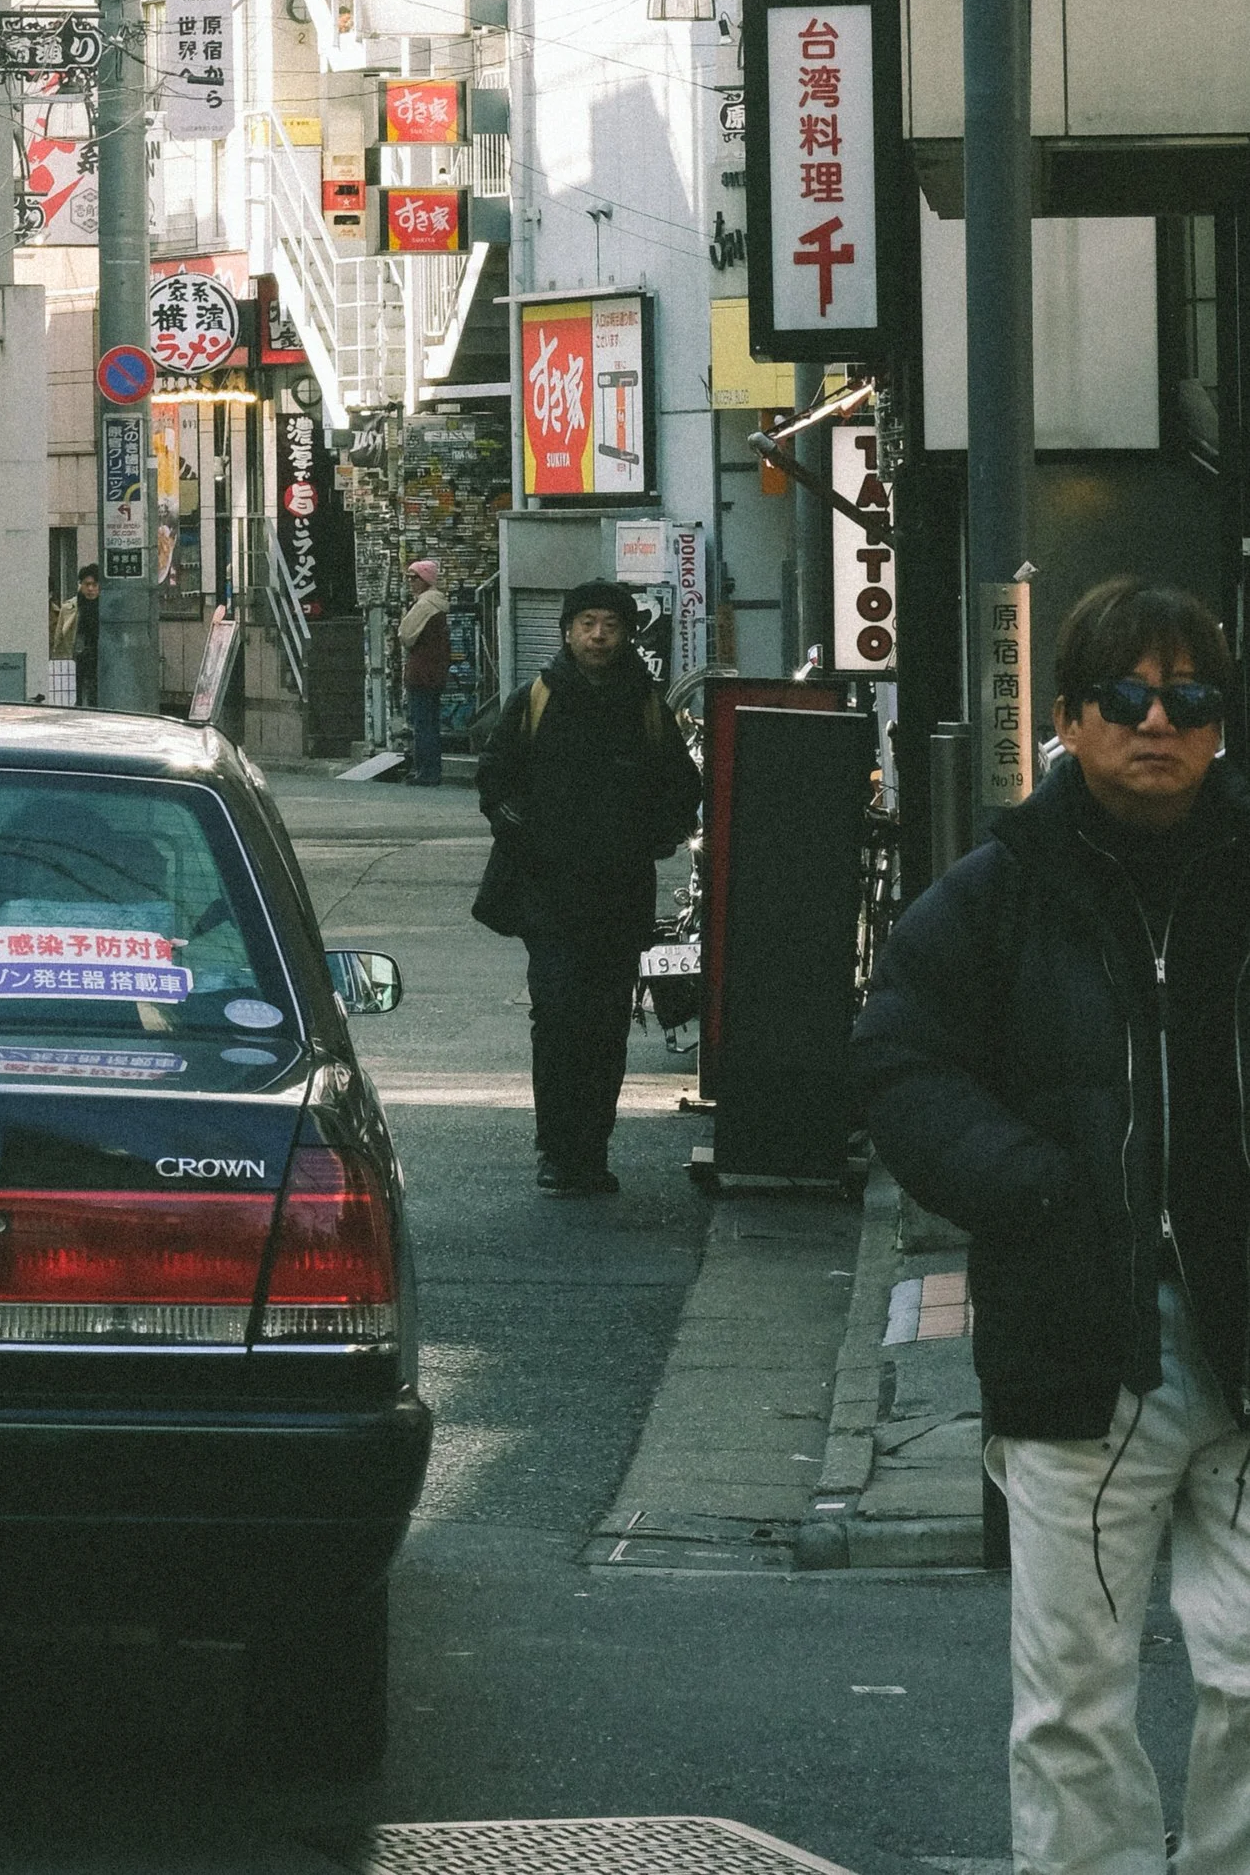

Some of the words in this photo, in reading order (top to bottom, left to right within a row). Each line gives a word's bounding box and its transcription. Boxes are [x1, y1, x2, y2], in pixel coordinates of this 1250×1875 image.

[202, 15, 223, 110] 原宿から
[394, 89, 449, 127] すき家
[798, 18, 844, 203] 台湾料理
[395, 197, 450, 235] すき家
[167, 279, 209, 303] 家系
[156, 333, 232, 369] ラーメン
[529, 328, 585, 445] すき家
[546, 452, 571, 468] SUKIYA
[855, 435, 893, 662] TATTOO
[993, 604, 1020, 765] 原宿商店会
[110, 974, 182, 995] 搭載車
[155, 1157, 265, 1178] CROWN
